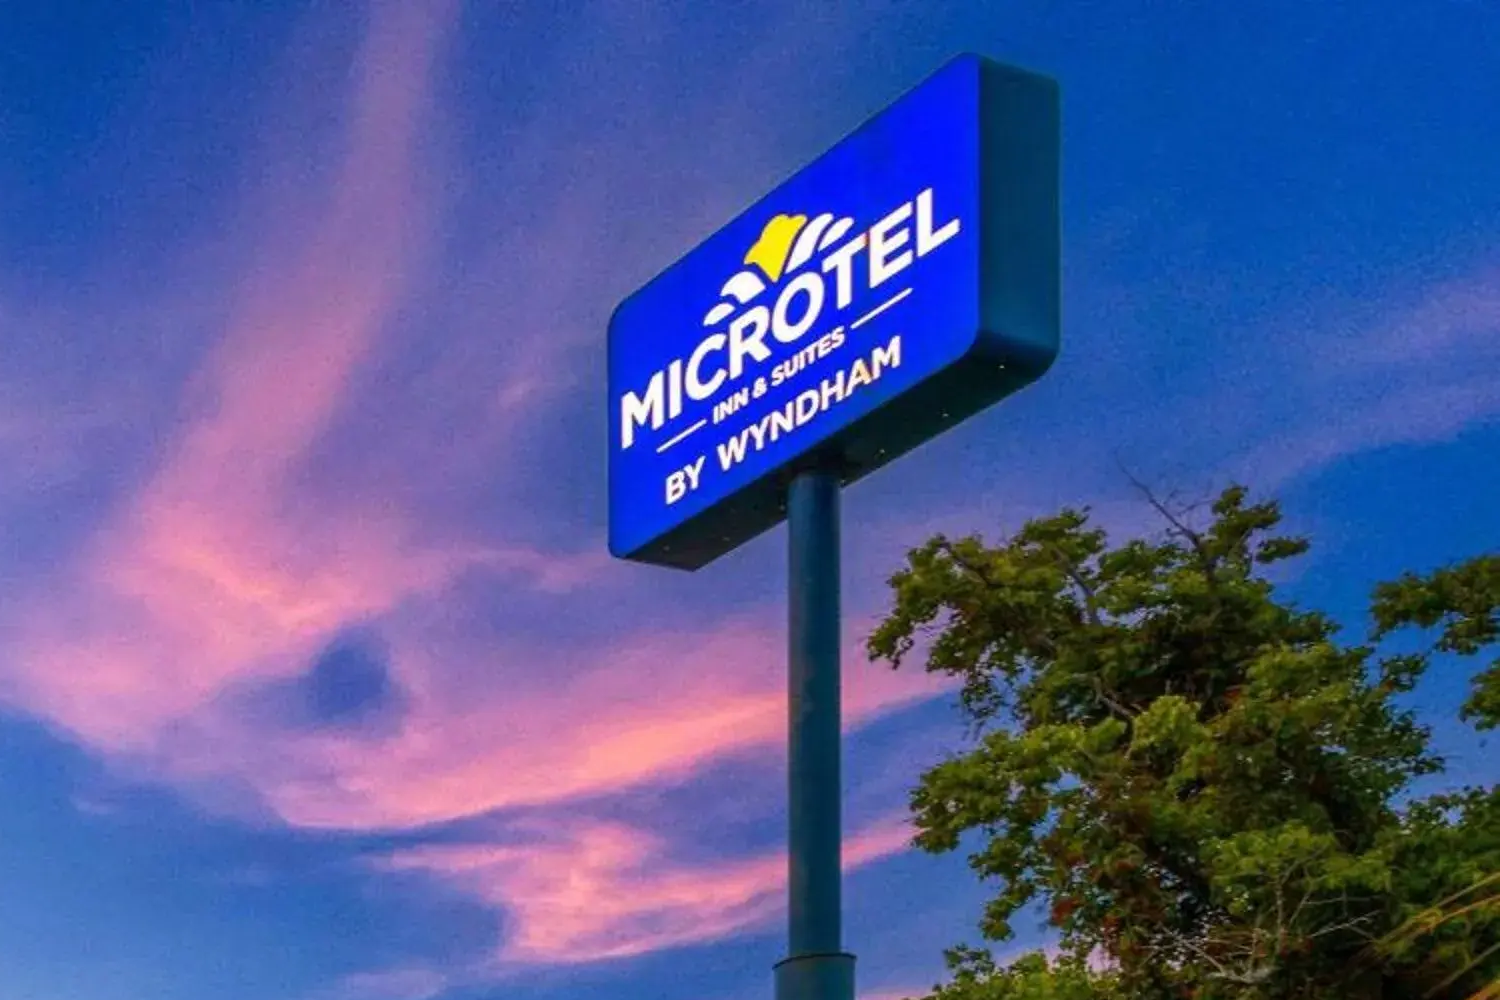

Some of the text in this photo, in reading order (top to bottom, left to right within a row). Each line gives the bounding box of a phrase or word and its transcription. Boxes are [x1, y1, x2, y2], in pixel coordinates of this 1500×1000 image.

[621, 188, 960, 450] MICROTEL
[713, 326, 845, 424] INN & SUITES
[665, 336, 901, 505] BY WYNDHAM
